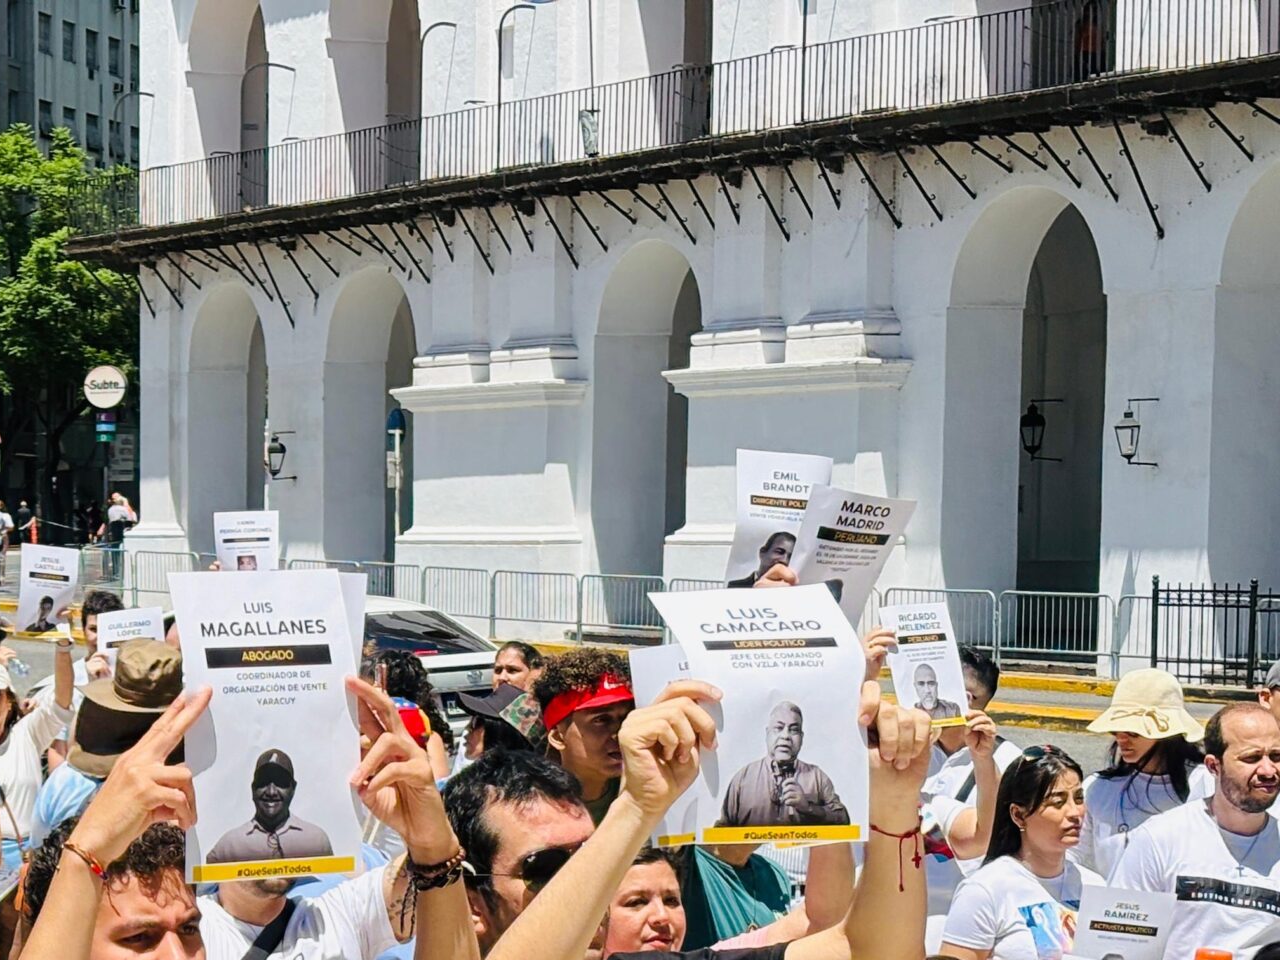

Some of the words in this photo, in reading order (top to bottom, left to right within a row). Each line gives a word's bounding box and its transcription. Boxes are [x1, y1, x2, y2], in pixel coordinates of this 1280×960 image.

[90, 380, 120, 390] Subte
[774, 471, 800, 482] EMIL
[763, 482, 810, 494] BRANDT
[840, 500, 890, 518] MARCO
[836, 516, 884, 530] MADRID
[834, 532, 878, 544] PERUANO
[244, 602, 273, 614] LUIS
[726, 608, 778, 620] LUIS
[898, 612, 937, 622] RICARDO
[108, 620, 152, 630] GUILLERMO
[200, 619, 326, 637] MAGALLANES
[700, 620, 822, 634] CAMACARO
[242, 650, 294, 662] ABOGADO
[730, 653, 752, 661] JEFE
[754, 652, 772, 660] DEL
[773, 652, 822, 660] COMANDO
[732, 660, 753, 668] CON
[756, 660, 780, 668] VZLA
[782, 660, 824, 668] YARACUY
[236, 671, 298, 680] COORDINADOR
[300, 670, 311, 678] DE
[222, 684, 286, 694] ORGANIZACIÓN
[288, 684, 298, 692] DE
[300, 683, 327, 691] VENTE
[256, 697, 296, 705] YARACUY
[743, 830, 818, 840] #QueSeanTodos
[237, 865, 312, 876] #QueSeanTodos
[1094, 922, 1124, 932] ACTIVISTA
